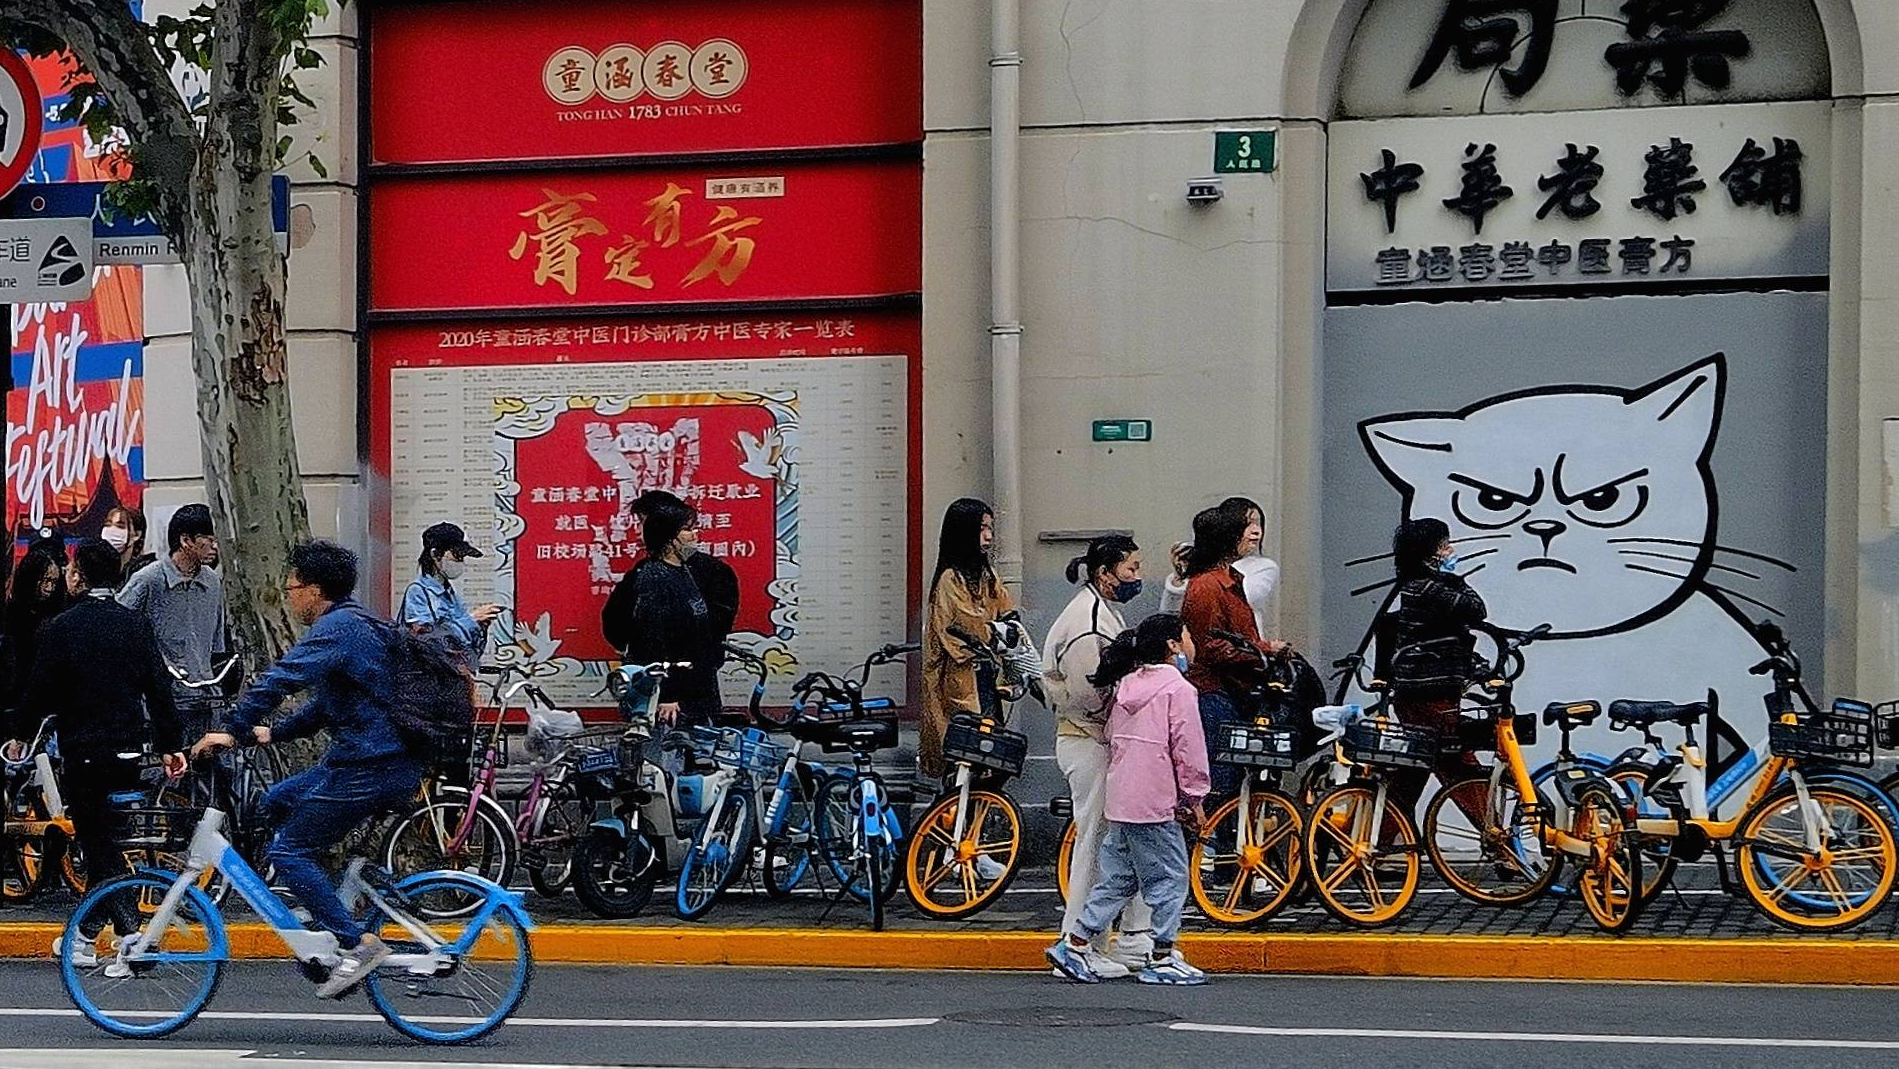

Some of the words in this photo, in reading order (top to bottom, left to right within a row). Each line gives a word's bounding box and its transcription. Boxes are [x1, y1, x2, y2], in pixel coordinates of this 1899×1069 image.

[554, 51, 734, 94] 童涵春堂
[556, 110, 592, 122] TONG
[595, 110, 623, 121] HAN
[628, 104, 661, 121] 1783
[665, 105, 701, 118] CHUN
[706, 103, 742, 116] TANG
[1237, 135, 1252, 158] 3
[99, 242, 159, 257] Renmin
[27, 312, 89, 435] Art
